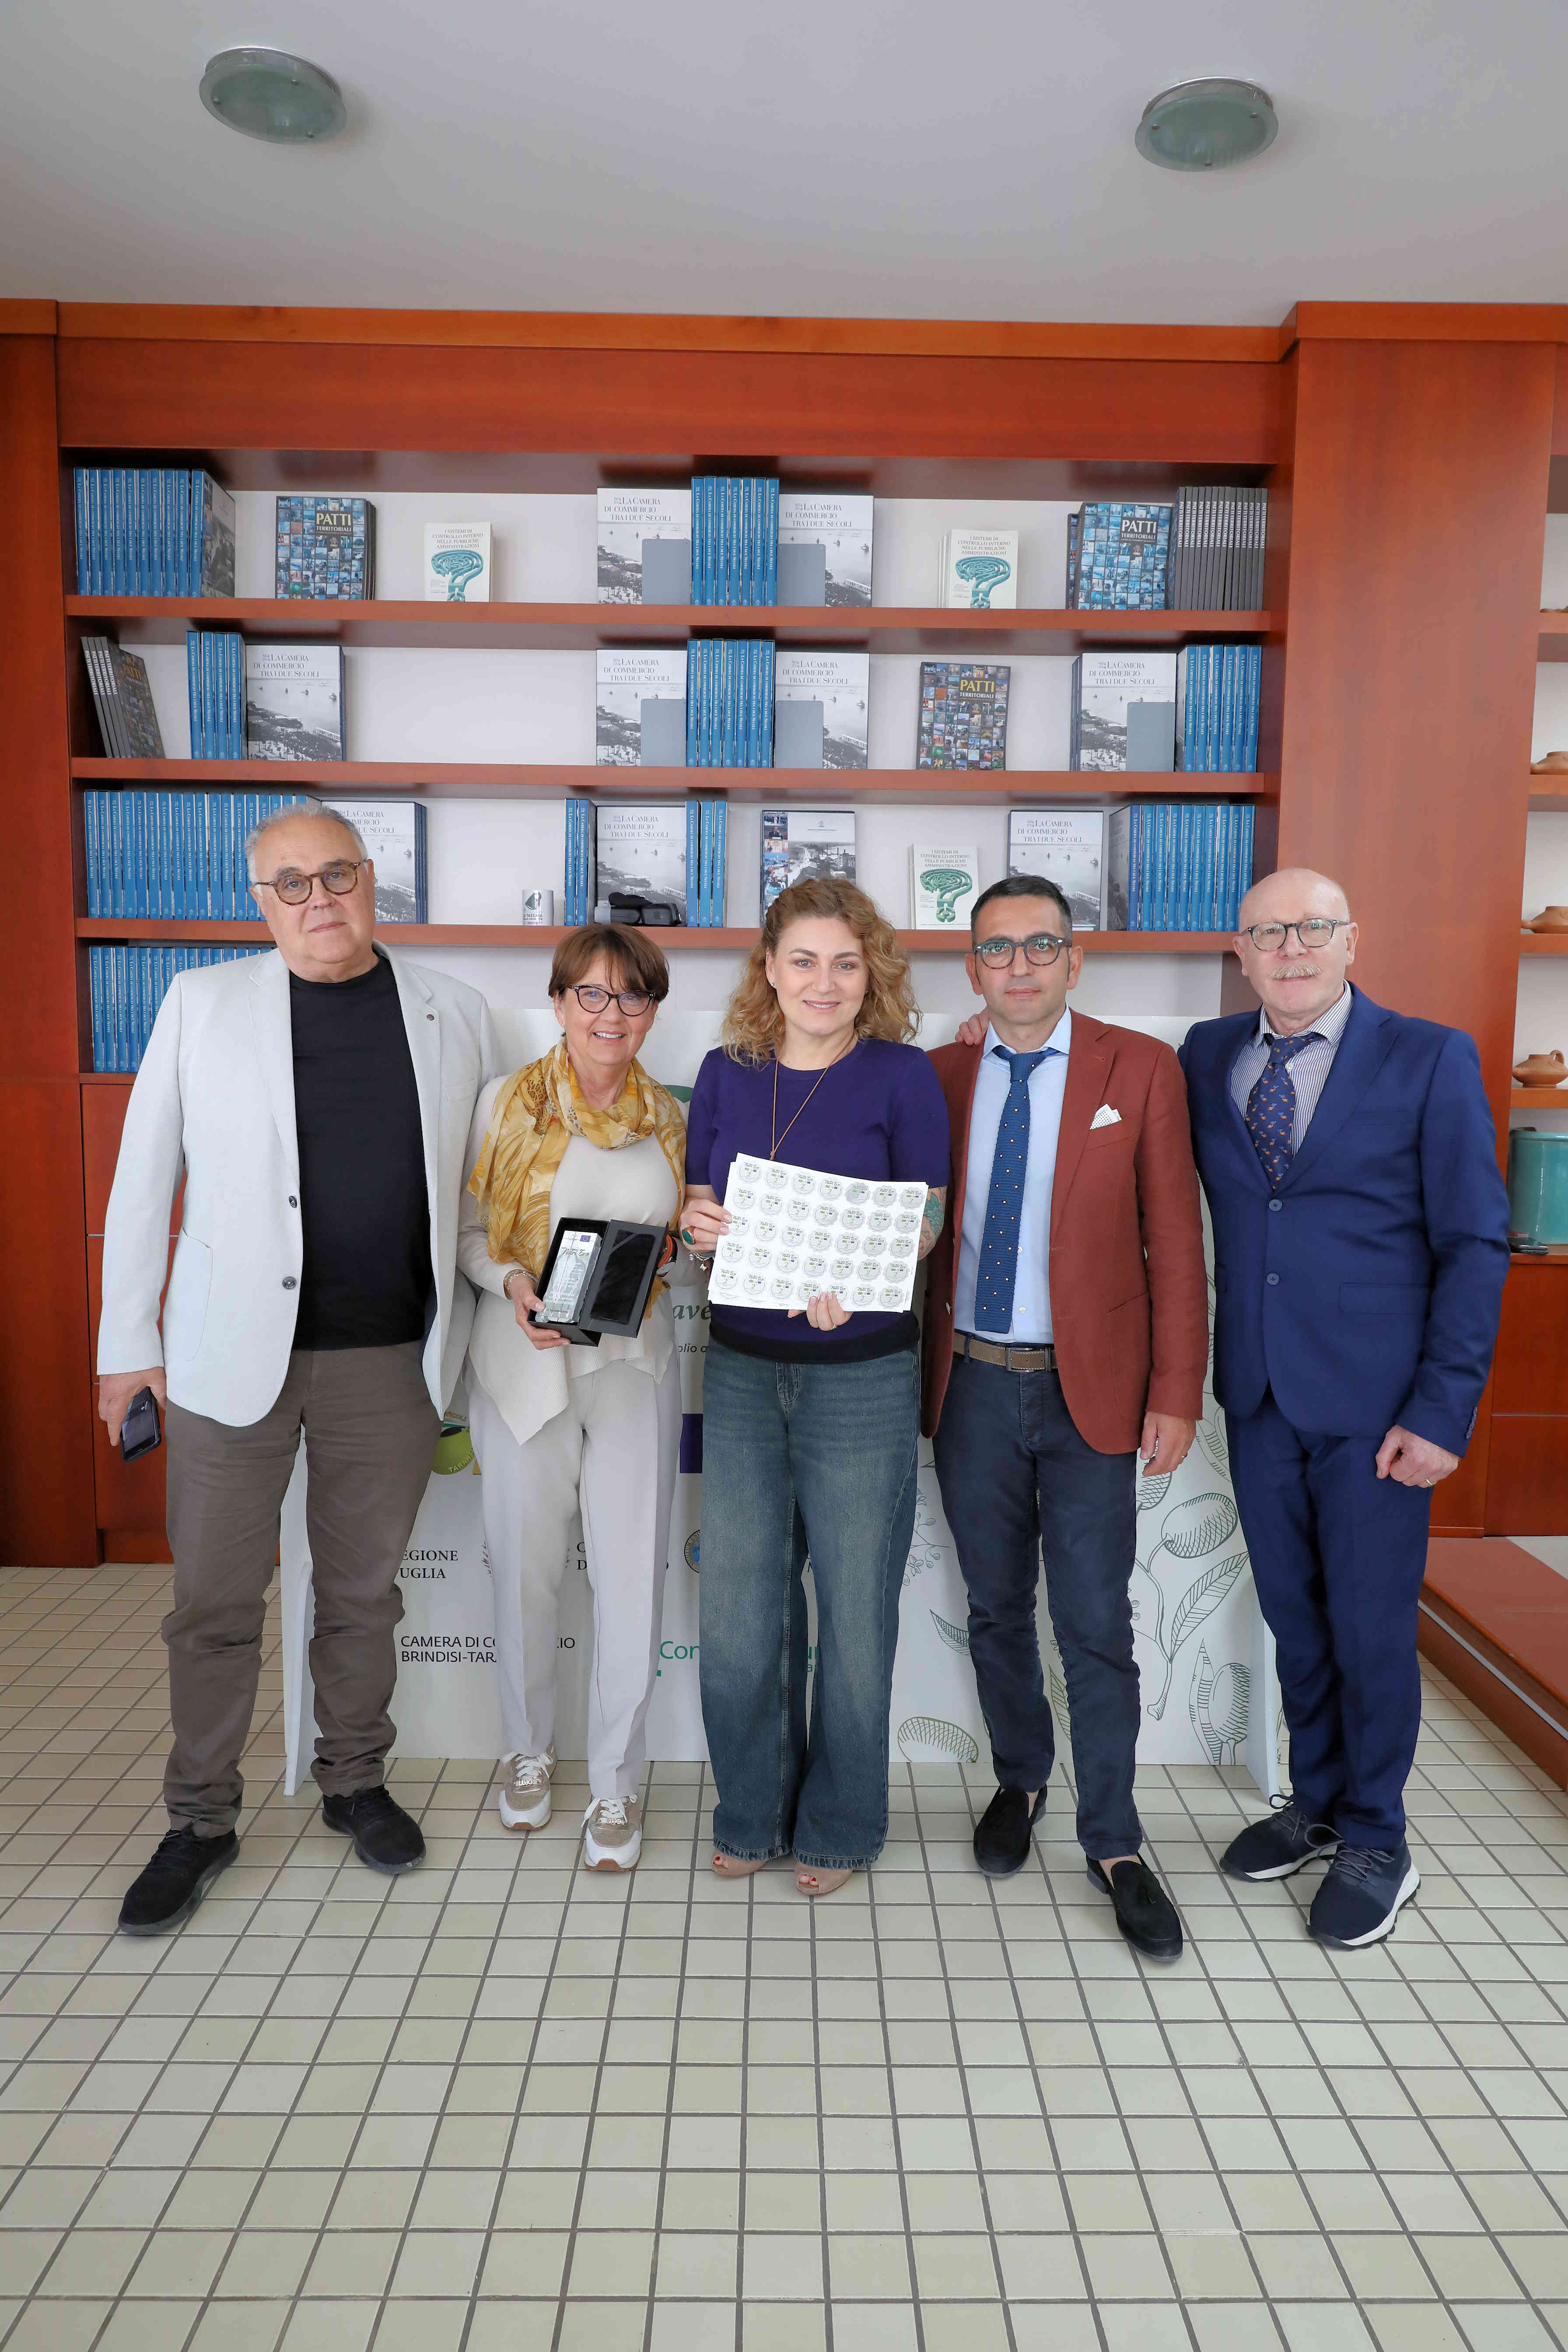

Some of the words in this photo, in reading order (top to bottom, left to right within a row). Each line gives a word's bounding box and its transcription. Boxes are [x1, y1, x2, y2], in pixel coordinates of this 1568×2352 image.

[316, 513, 351, 525] PATTI
[1122, 520, 1157, 533] PATTI
[960, 679, 994, 693] PATTI
[402, 1550, 458, 1561] EGIONE
[399, 1568, 446, 1579] UGLIA
[401, 1636, 461, 1647] CAMERA
[466, 1637, 479, 1648] DI
[402, 1651, 497, 1663] BRINDISI-TAR
